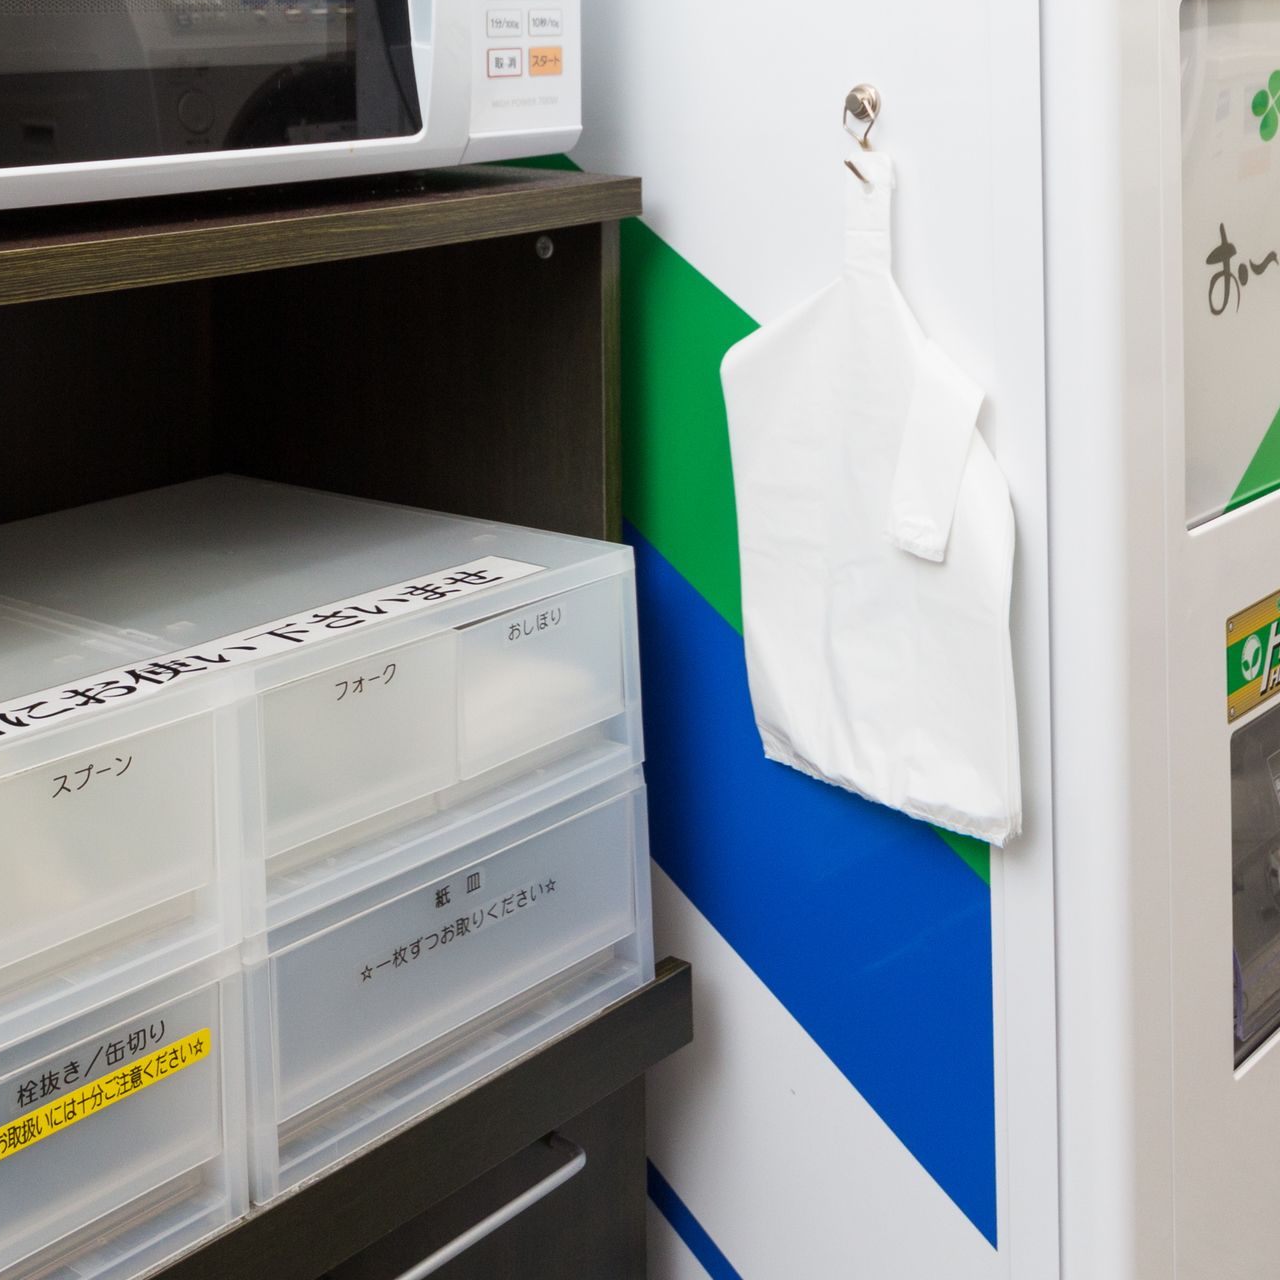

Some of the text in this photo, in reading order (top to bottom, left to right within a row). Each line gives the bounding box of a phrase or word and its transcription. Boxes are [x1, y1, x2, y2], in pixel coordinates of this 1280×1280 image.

[532, 55, 561, 68] スタート
[506, 604, 564, 644] おしぼり
[335, 661, 398, 703] フォーク
[51, 752, 135, 800] スプーン
[435, 871, 481, 910] 紙皿
[16, 1019, 166, 1109] 栓抜き／缶切り
